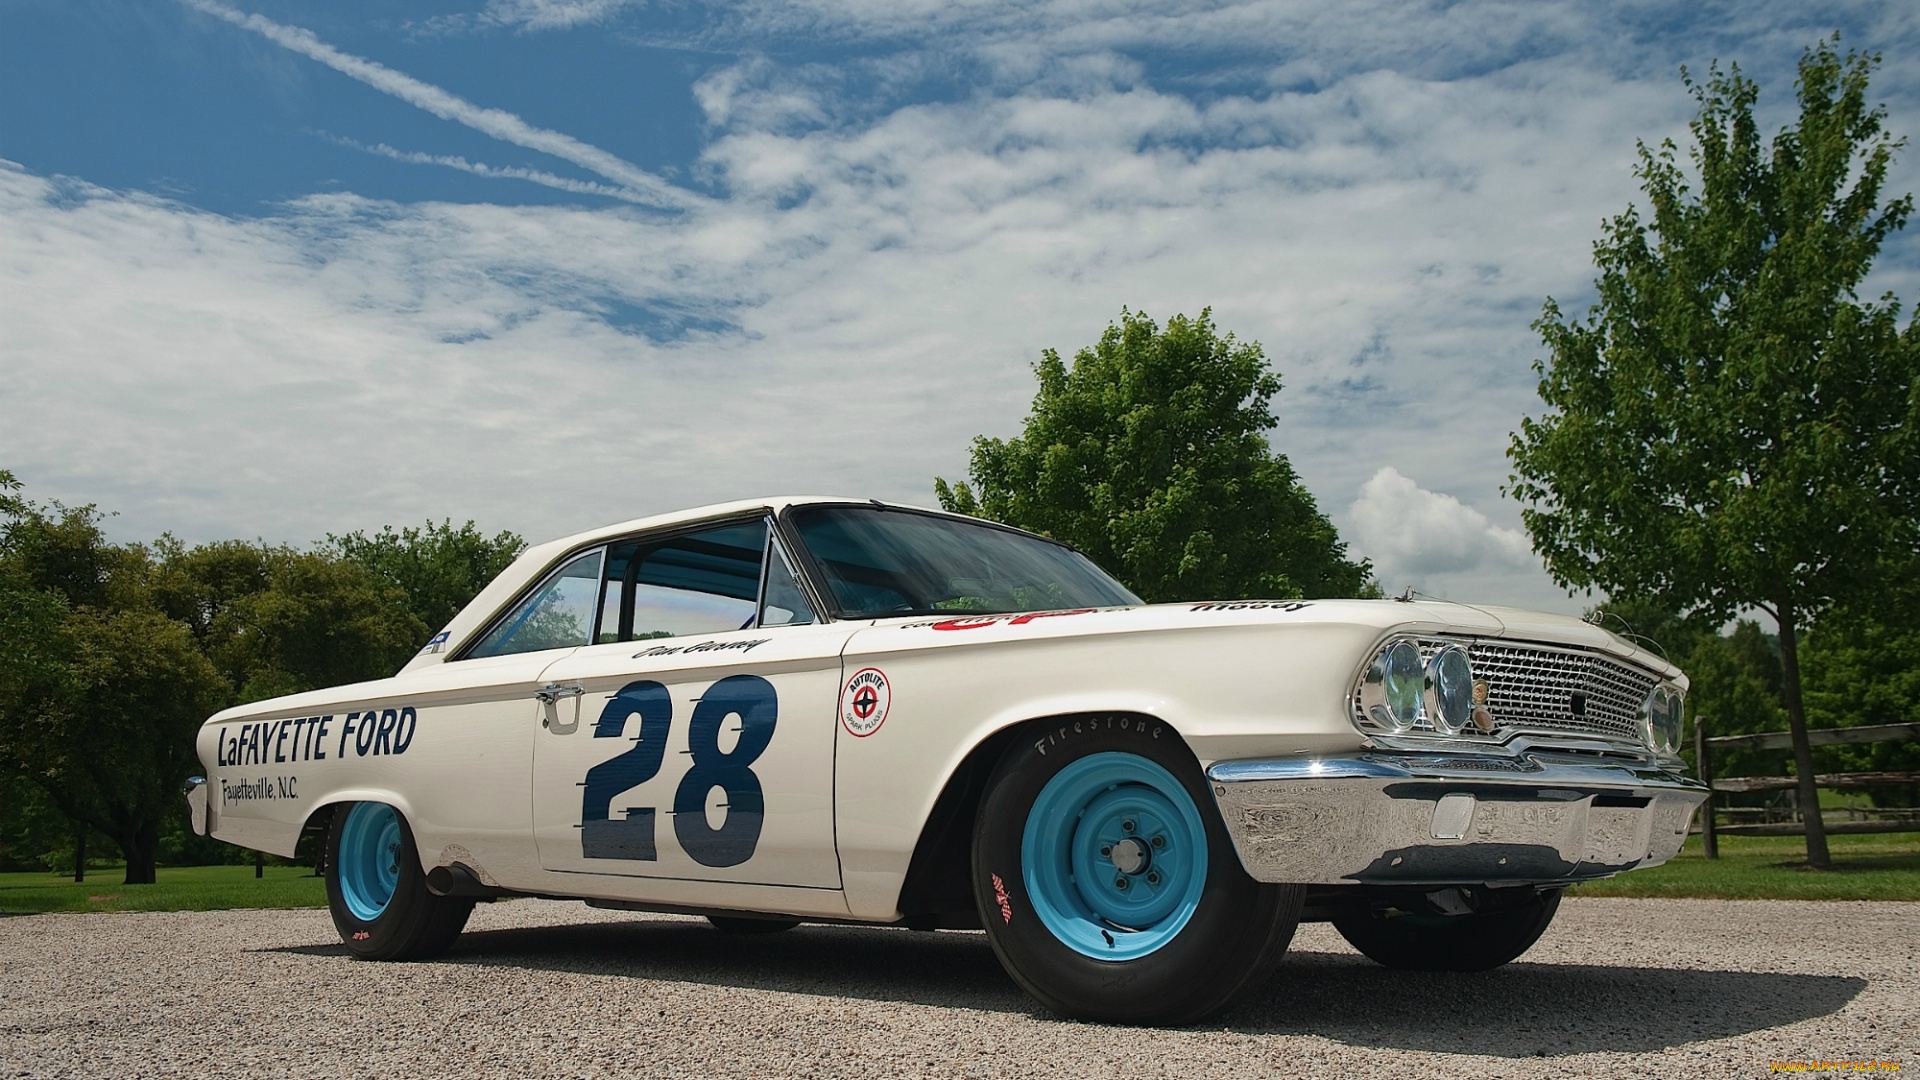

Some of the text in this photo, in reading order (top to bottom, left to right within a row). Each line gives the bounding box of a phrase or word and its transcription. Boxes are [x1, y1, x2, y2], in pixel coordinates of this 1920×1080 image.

[850, 672, 885, 693] AUTOLITE
[217, 706, 417, 767] LaFAYETTE FORD
[846, 710, 883, 731] SPARK PLUGS
[1034, 716, 1162, 755] Firestone
[578, 674, 778, 868] 28
[221, 776, 299, 806] Fayetteville, N.C.
